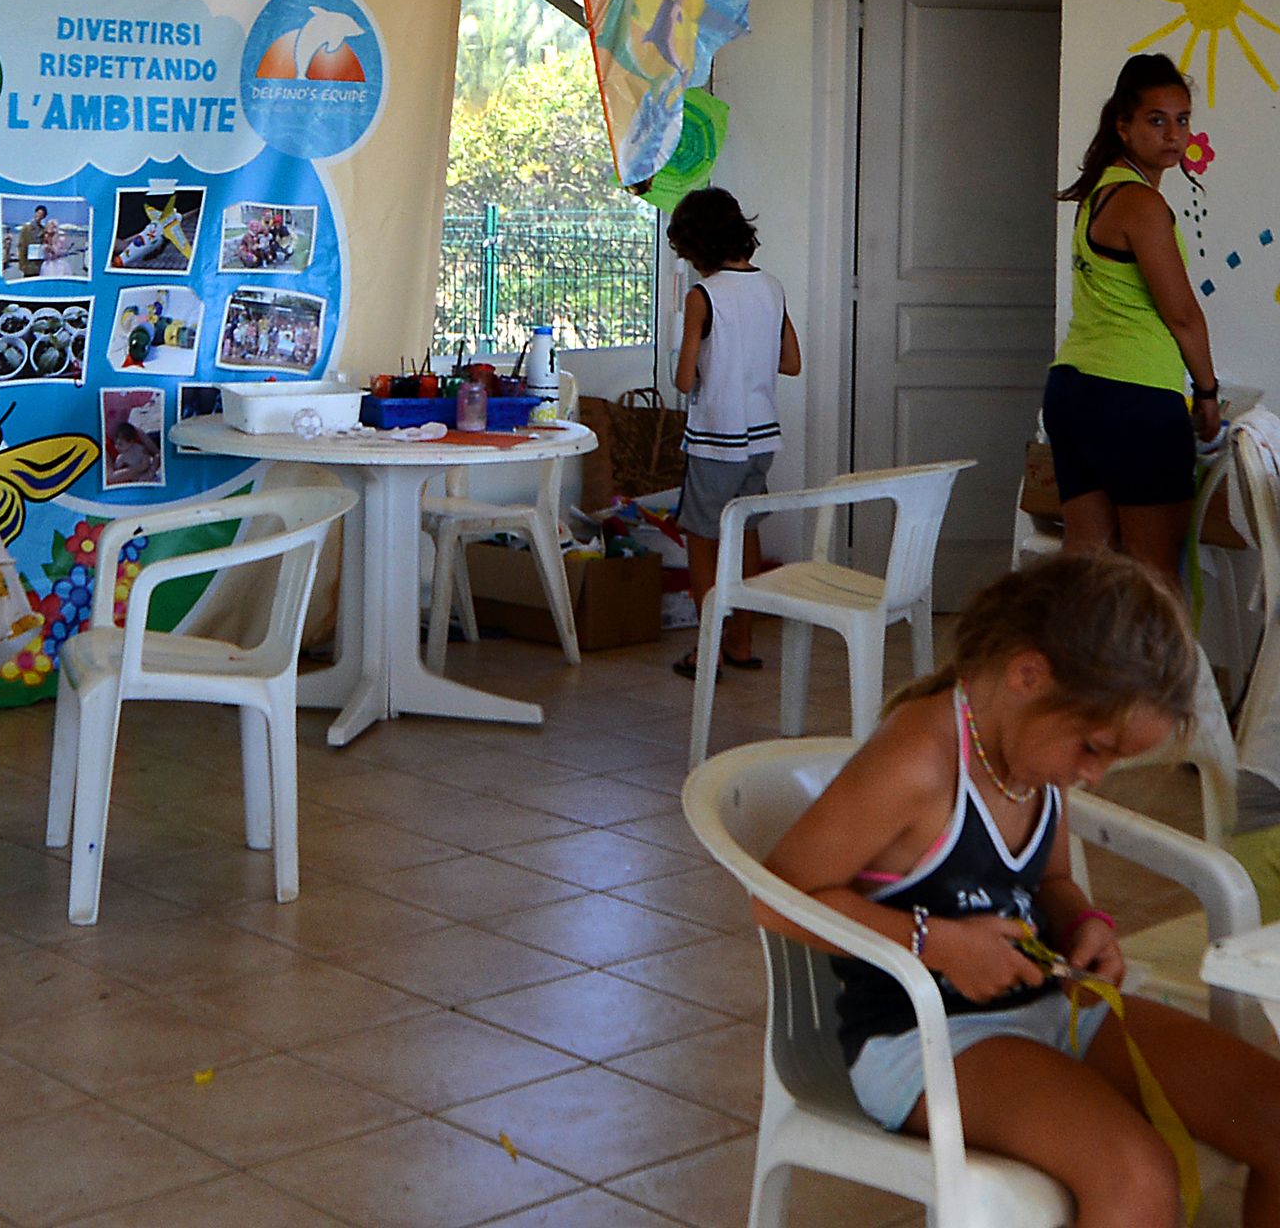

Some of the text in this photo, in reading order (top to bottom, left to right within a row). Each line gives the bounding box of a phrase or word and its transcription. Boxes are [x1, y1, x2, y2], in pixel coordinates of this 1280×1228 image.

[57, 16, 201, 46] DIVERTIRSI
[40, 53, 217, 82] RISPETTANDO
[320, 88, 368, 103] EQUIPE
[8, 92, 237, 133] L'AMBIENTE
